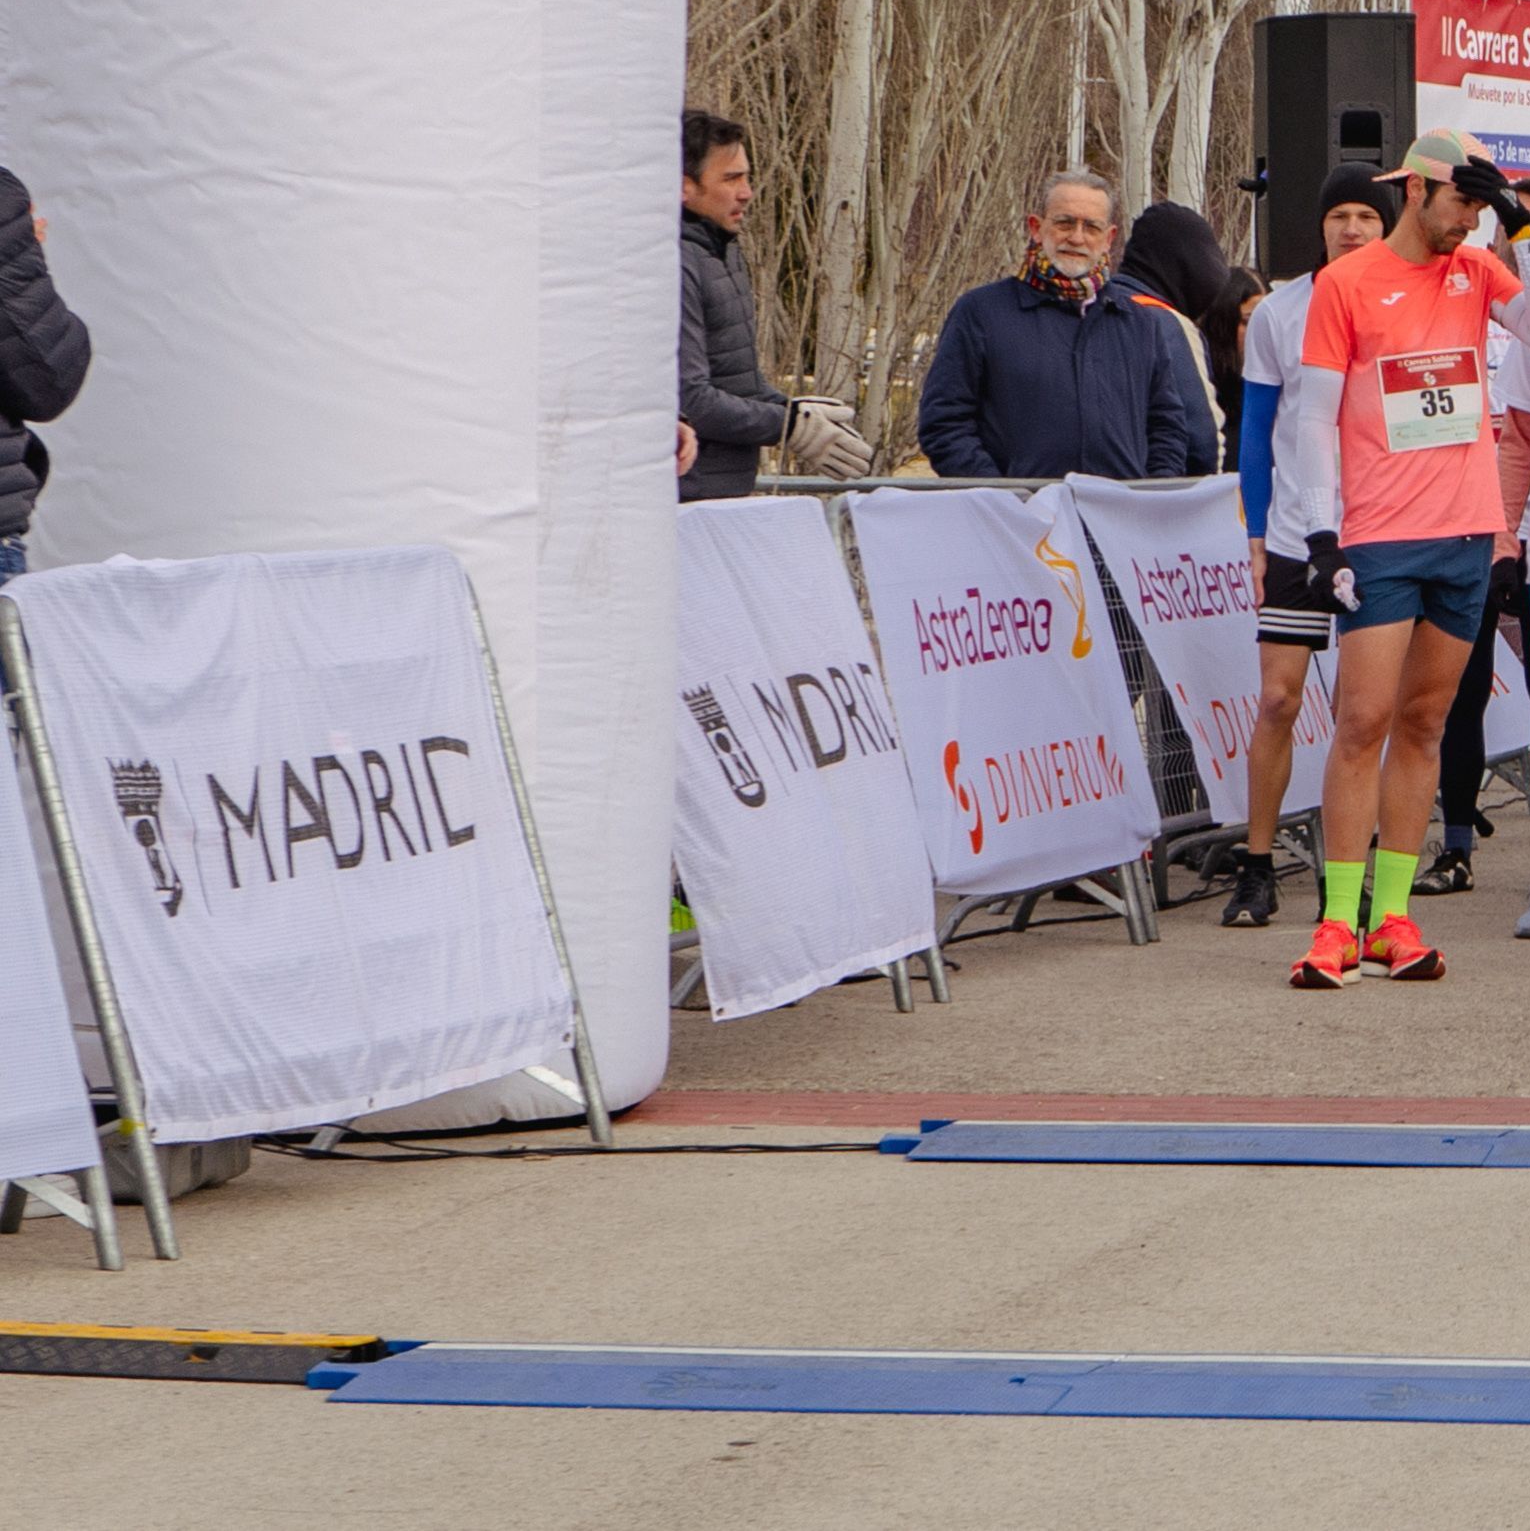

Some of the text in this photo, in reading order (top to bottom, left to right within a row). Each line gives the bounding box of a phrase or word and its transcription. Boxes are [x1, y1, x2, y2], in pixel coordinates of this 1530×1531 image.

[1441, 16, 1453, 56] II
[1455, 18, 1519, 66] Carrera
[1503, 87, 1516, 107] por
[1517, 89, 1525, 105] la
[1506, 138, 1517, 163] de
[1420, 387, 1455, 418] 35
[984, 734, 1126, 824] DIAVERUM
